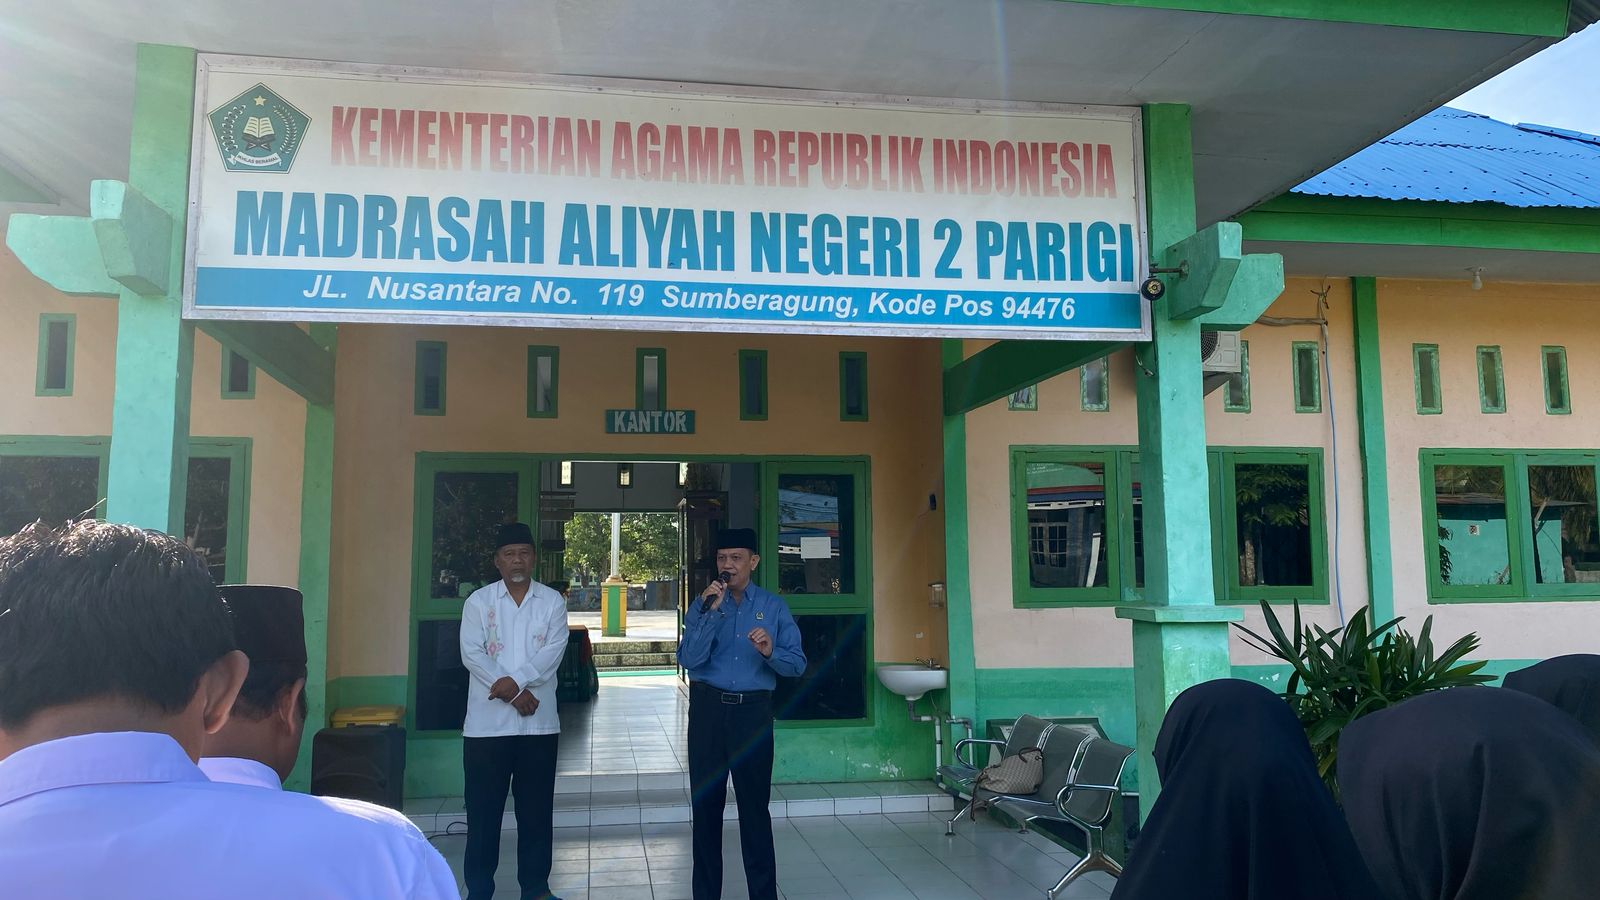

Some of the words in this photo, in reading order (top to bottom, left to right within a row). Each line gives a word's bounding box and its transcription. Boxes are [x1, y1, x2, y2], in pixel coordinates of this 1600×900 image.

[332, 106, 601, 178] KEMENTERIAN
[611, 121, 745, 187] AGAMA
[753, 128, 926, 194] REPUBLIK
[932, 137, 1118, 199] INDONESIA
[233, 190, 546, 265] MADRASAH
[558, 202, 736, 272] ALIYAH
[750, 210, 921, 278] NEGERI
[933, 217, 963, 280] 2
[975, 220, 1135, 283] PARIGI
[302, 273, 348, 300] JL.
[367, 275, 522, 304] Nusantara
[530, 280, 579, 306] No.
[597, 282, 645, 307] 119
[661, 284, 859, 320] Sumberagung,
[867, 291, 937, 317] Kode
[944, 294, 993, 317] Pos
[1001, 295, 1076, 321] 94476
[614, 410, 688, 433] KANTOR
